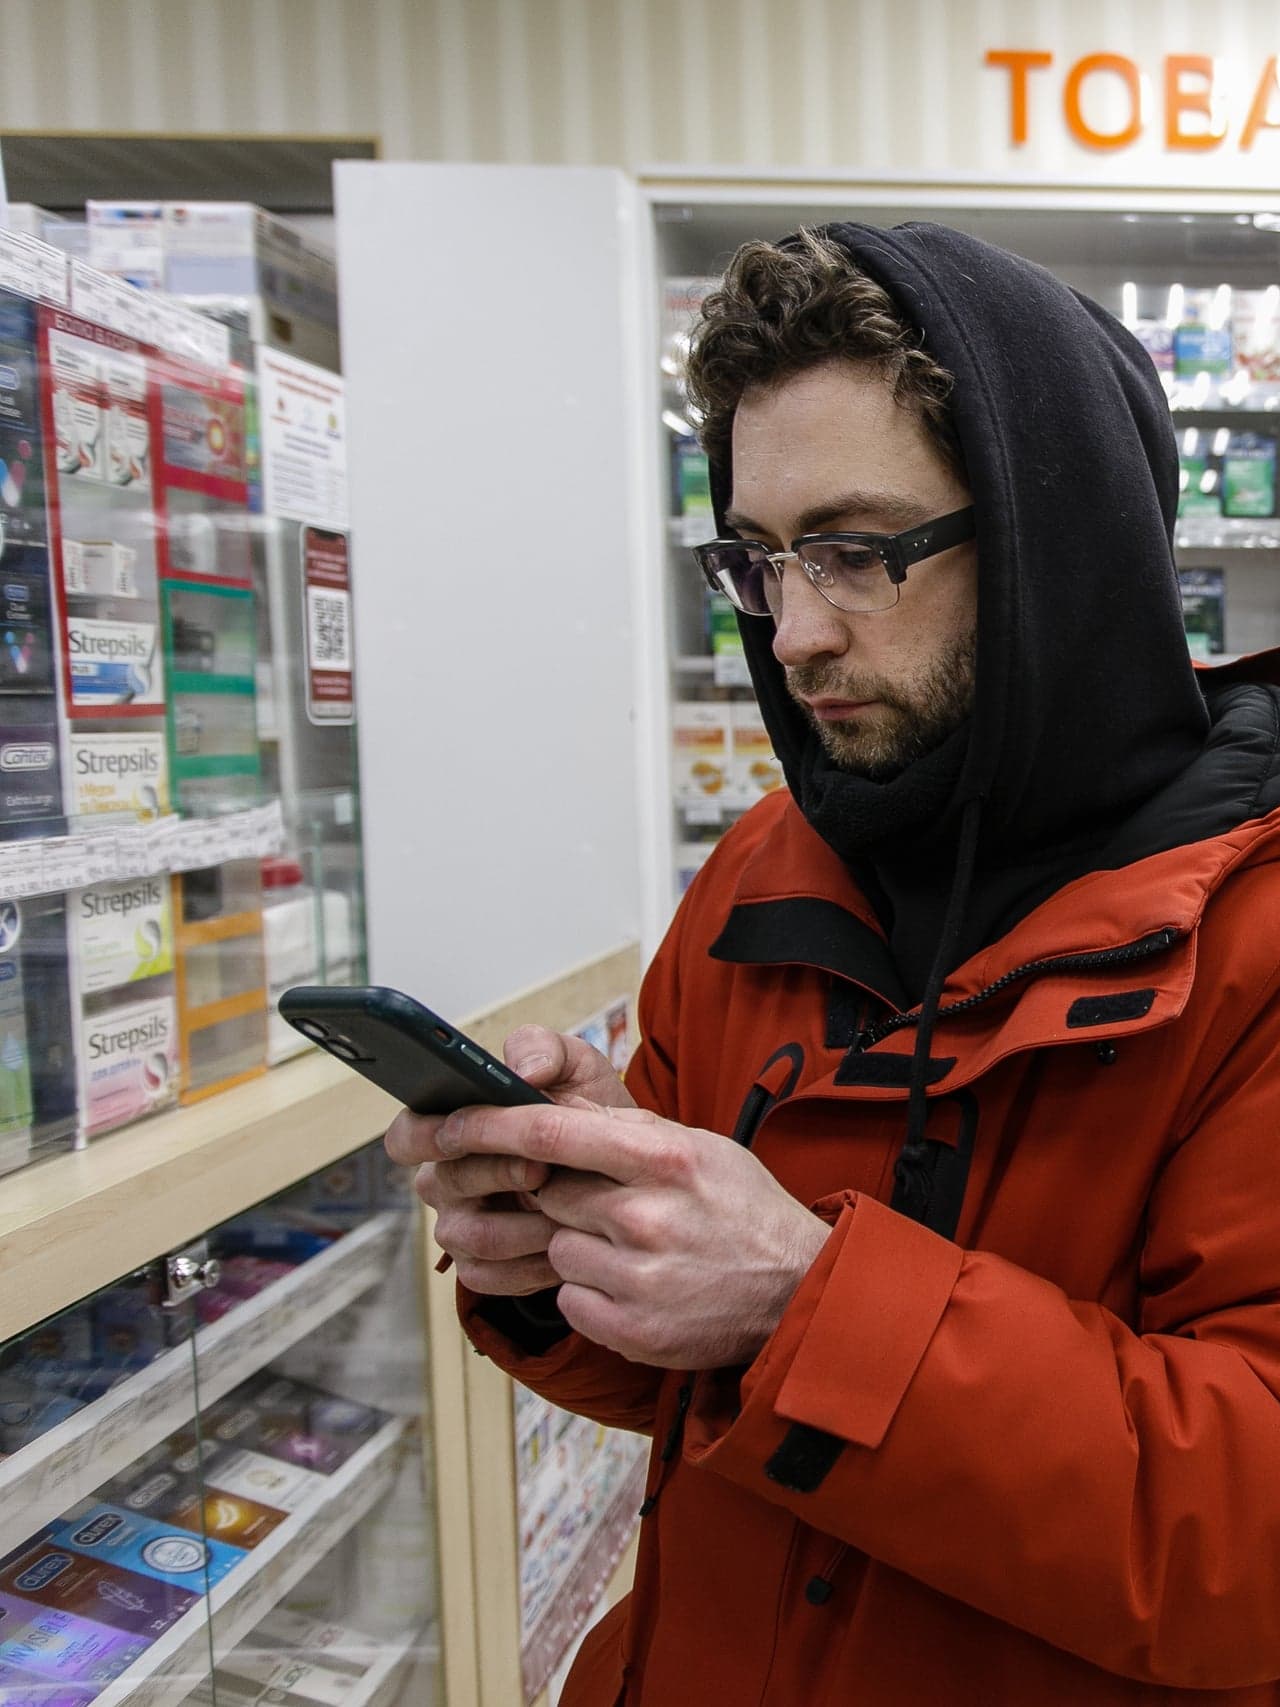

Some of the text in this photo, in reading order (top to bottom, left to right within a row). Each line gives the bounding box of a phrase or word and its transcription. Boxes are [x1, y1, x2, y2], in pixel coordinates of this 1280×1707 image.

[68, 629, 147, 660] Strepsils
[76, 746, 159, 779] Strepsils
[81, 882, 162, 918] Strepsils
[88, 1016, 168, 1060] Strepsils
[22, 1554, 73, 1586] durex
